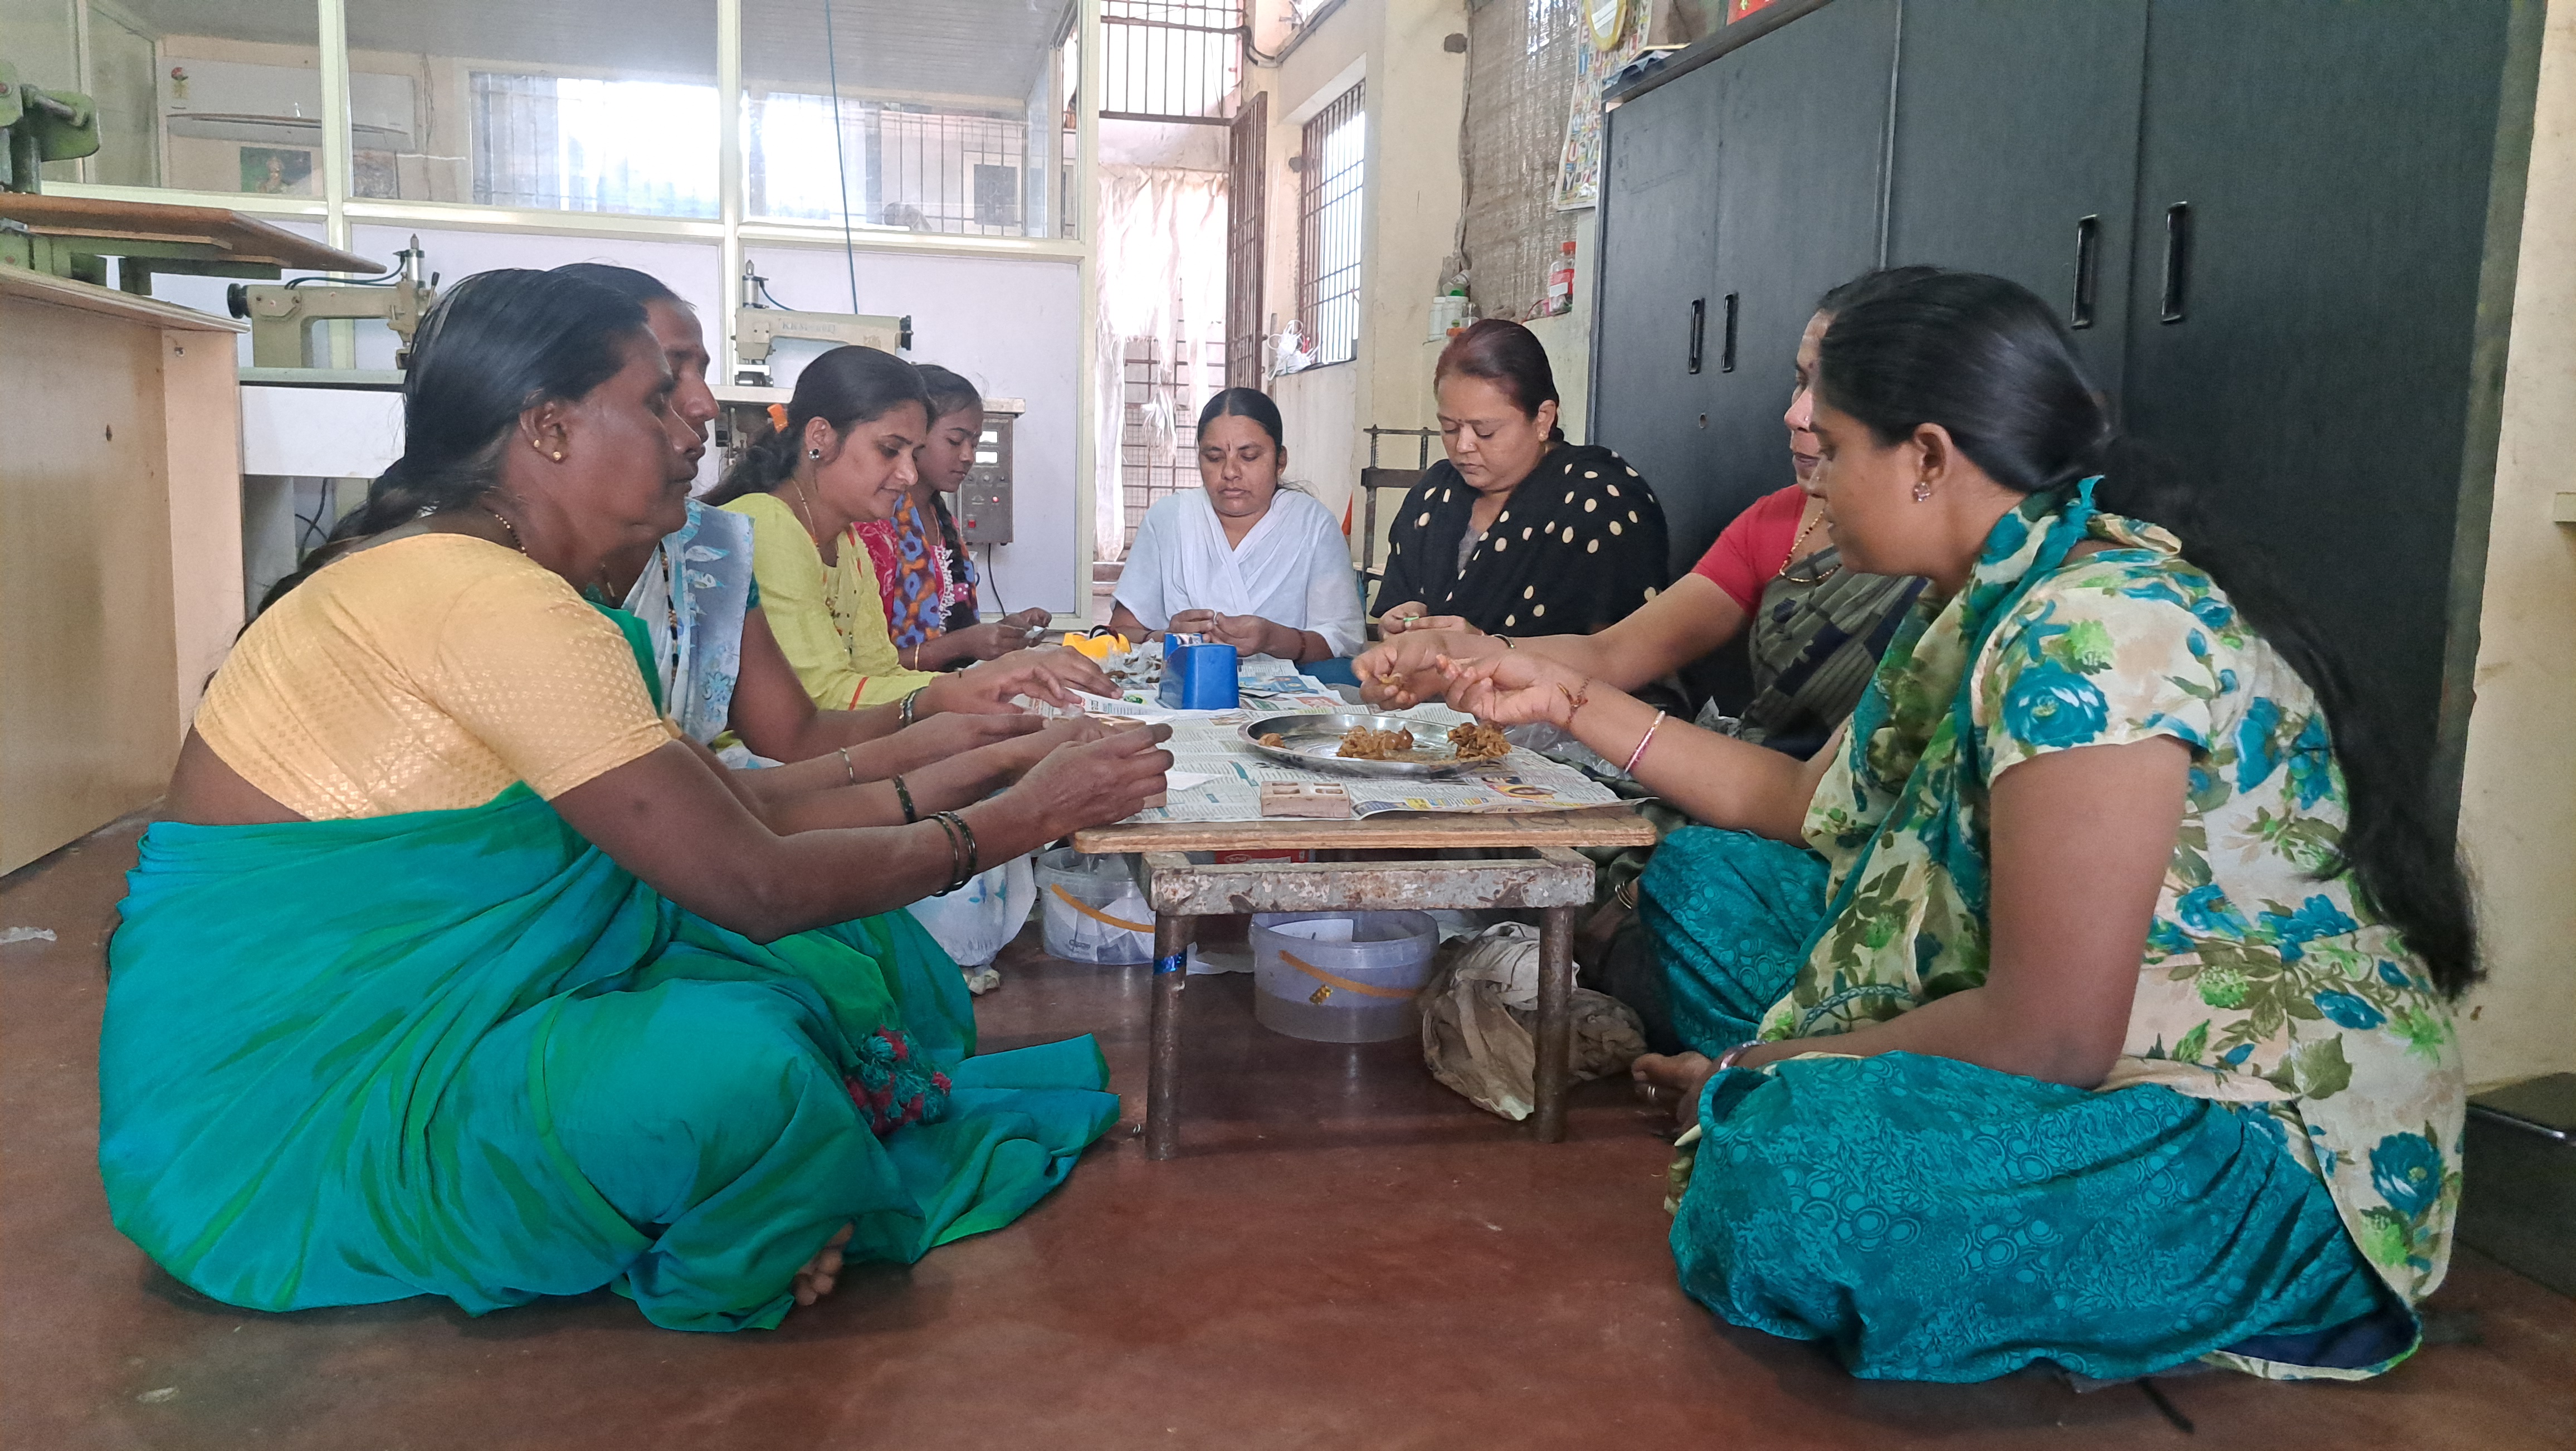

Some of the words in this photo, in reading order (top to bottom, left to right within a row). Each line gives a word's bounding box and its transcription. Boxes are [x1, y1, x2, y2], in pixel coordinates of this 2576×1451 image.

[1580, 26, 1589, 43] E
[1628, 36, 1636, 57] L
[1569, 143, 1578, 161] U
[1566, 173, 1574, 190] Y
